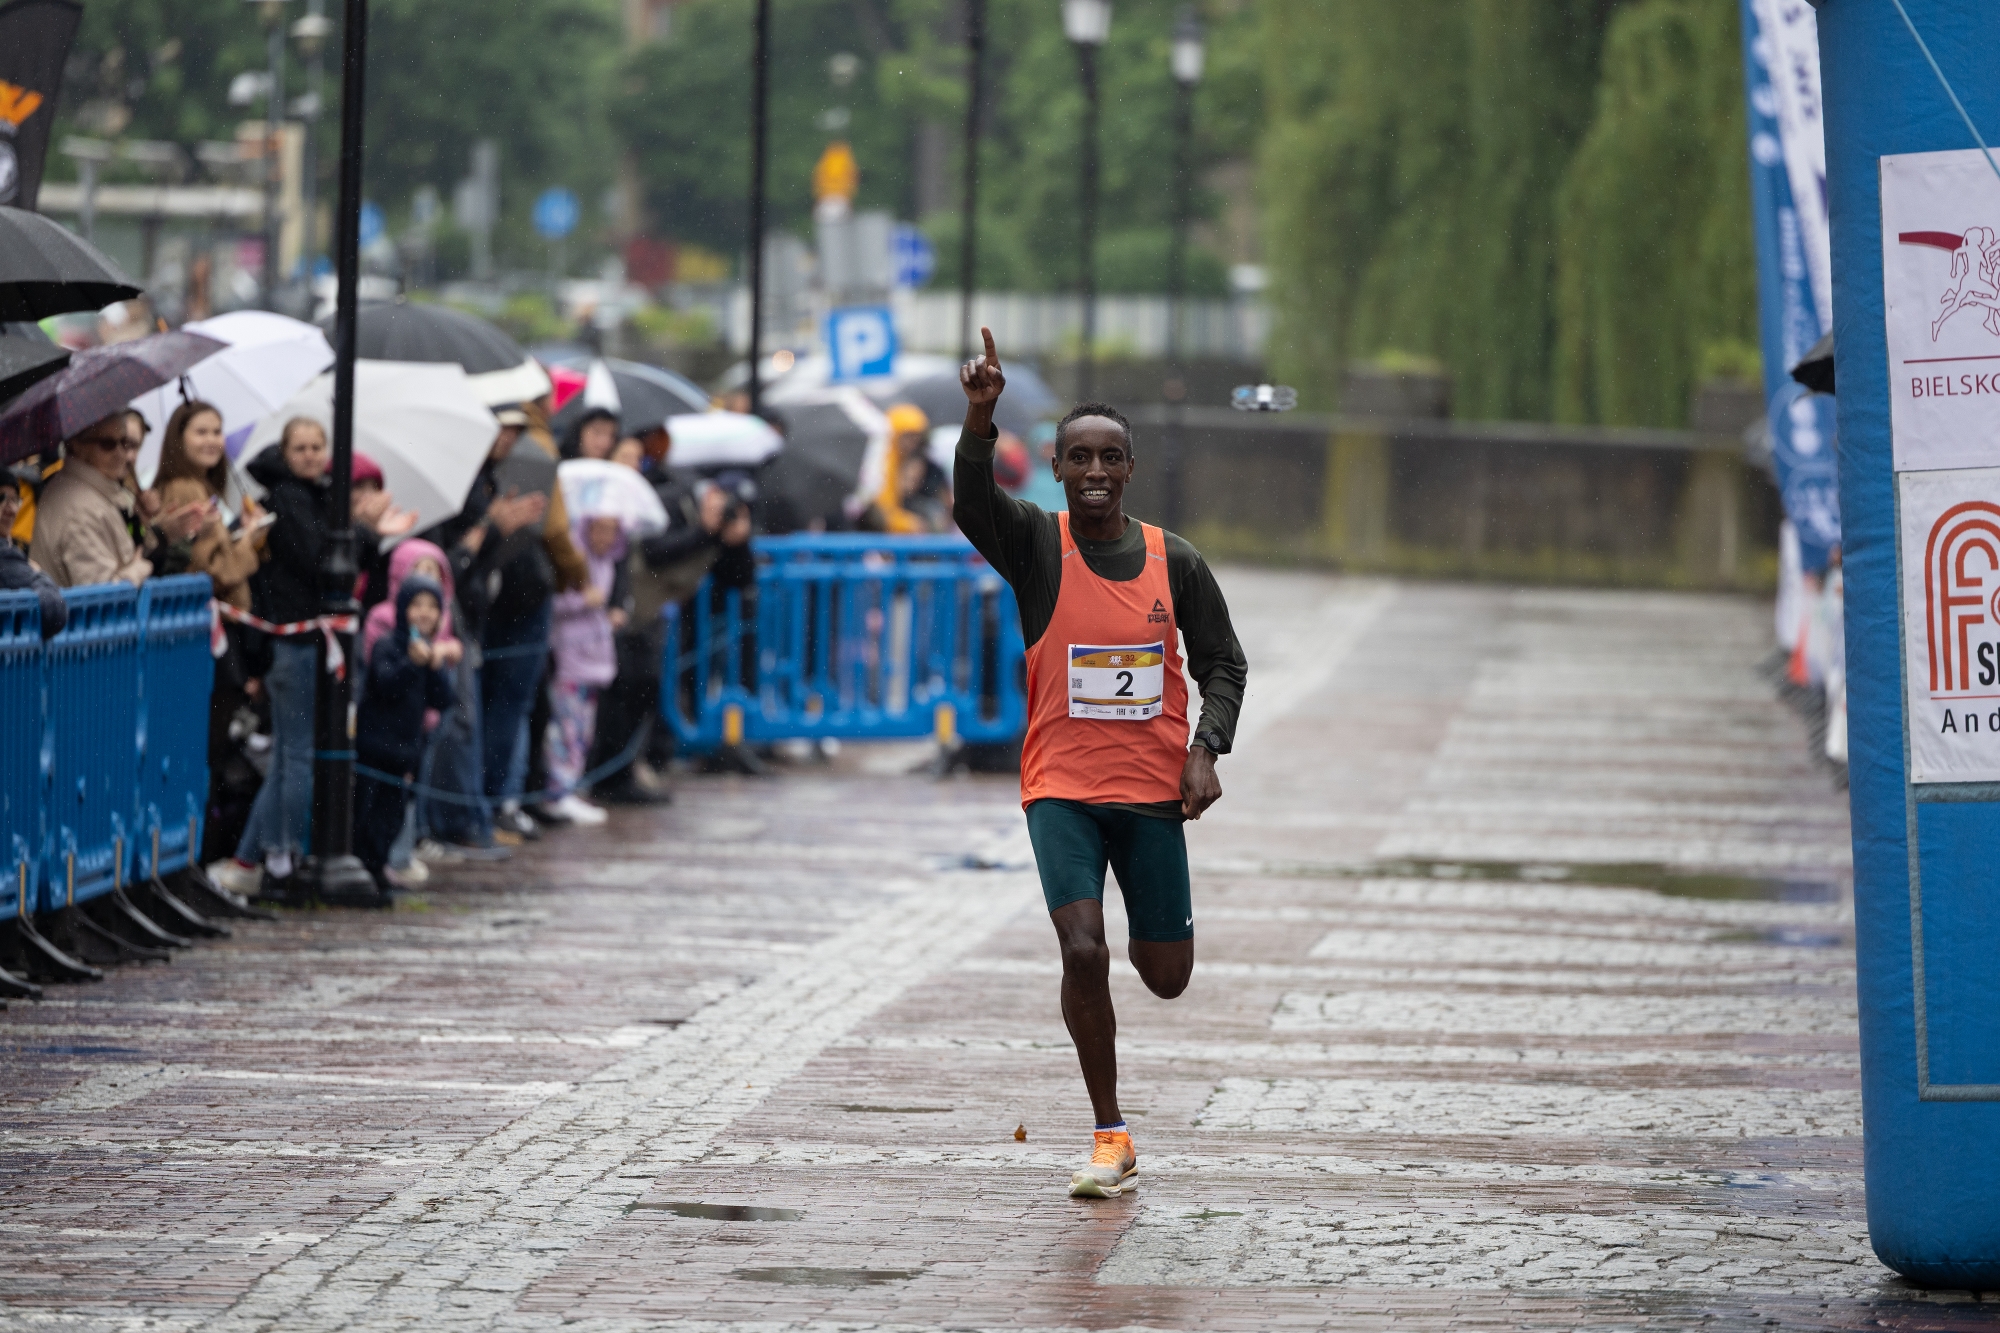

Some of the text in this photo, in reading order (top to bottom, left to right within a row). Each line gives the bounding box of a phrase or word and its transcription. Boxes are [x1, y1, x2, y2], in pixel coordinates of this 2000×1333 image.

[838, 313, 887, 379] P
[1147, 613, 1169, 623] PEAK
[1977, 641, 2000, 686] S
[1115, 670, 1134, 697] 2
